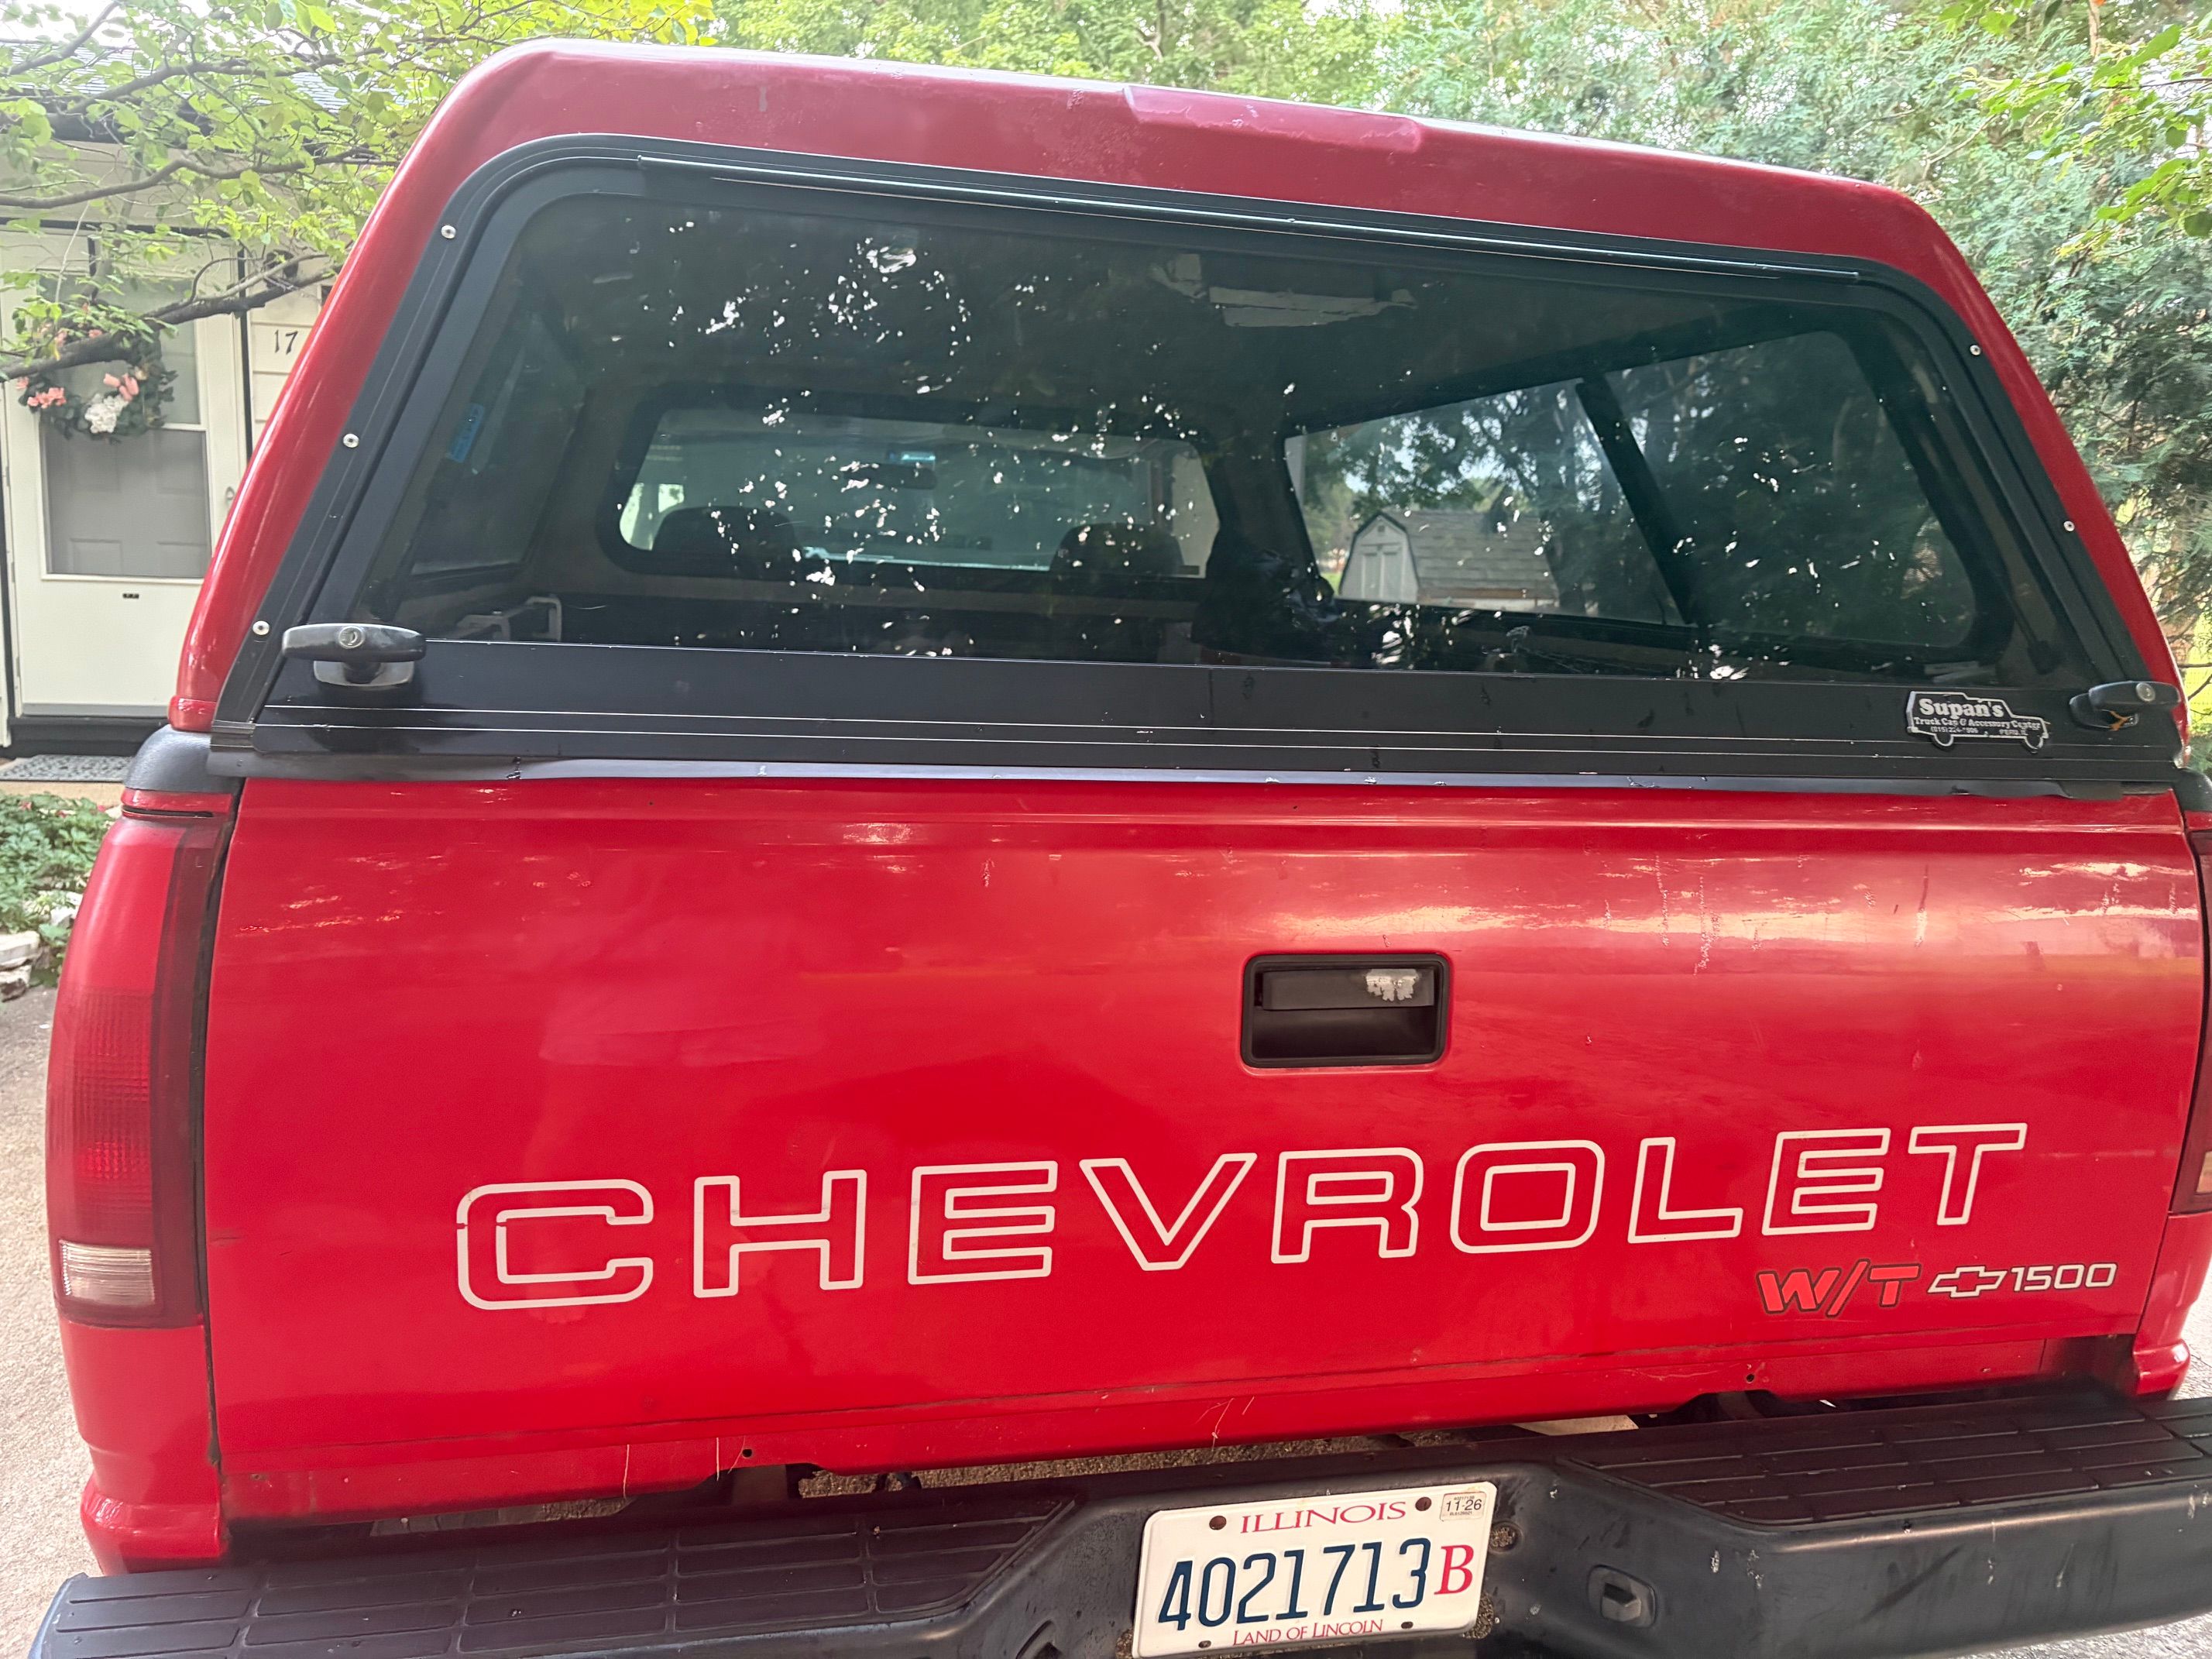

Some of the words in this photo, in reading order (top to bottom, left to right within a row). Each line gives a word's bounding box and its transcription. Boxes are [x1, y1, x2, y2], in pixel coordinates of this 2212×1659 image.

[274, 330, 298, 355] 17
[1918, 698, 2004, 720] Supan's
[1913, 716, 1940, 726] Truck
[1941, 718, 1959, 728] Cap
[1968, 720, 2011, 730] Accessory
[2011, 720, 2041, 730] Center
[456, 1122, 2028, 1310] CHEVROLET
[1756, 1258, 1922, 1317] W/T
[2011, 1262, 2118, 1292] 1500
[1240, 1500, 1407, 1534] ILLINOIS
[1446, 1498, 1482, 1512] 11-26
[1232, 1628, 1281, 1646] LAND
[1286, 1626, 1308, 1641] OF
[1313, 1619, 1383, 1638] LINCOLN
